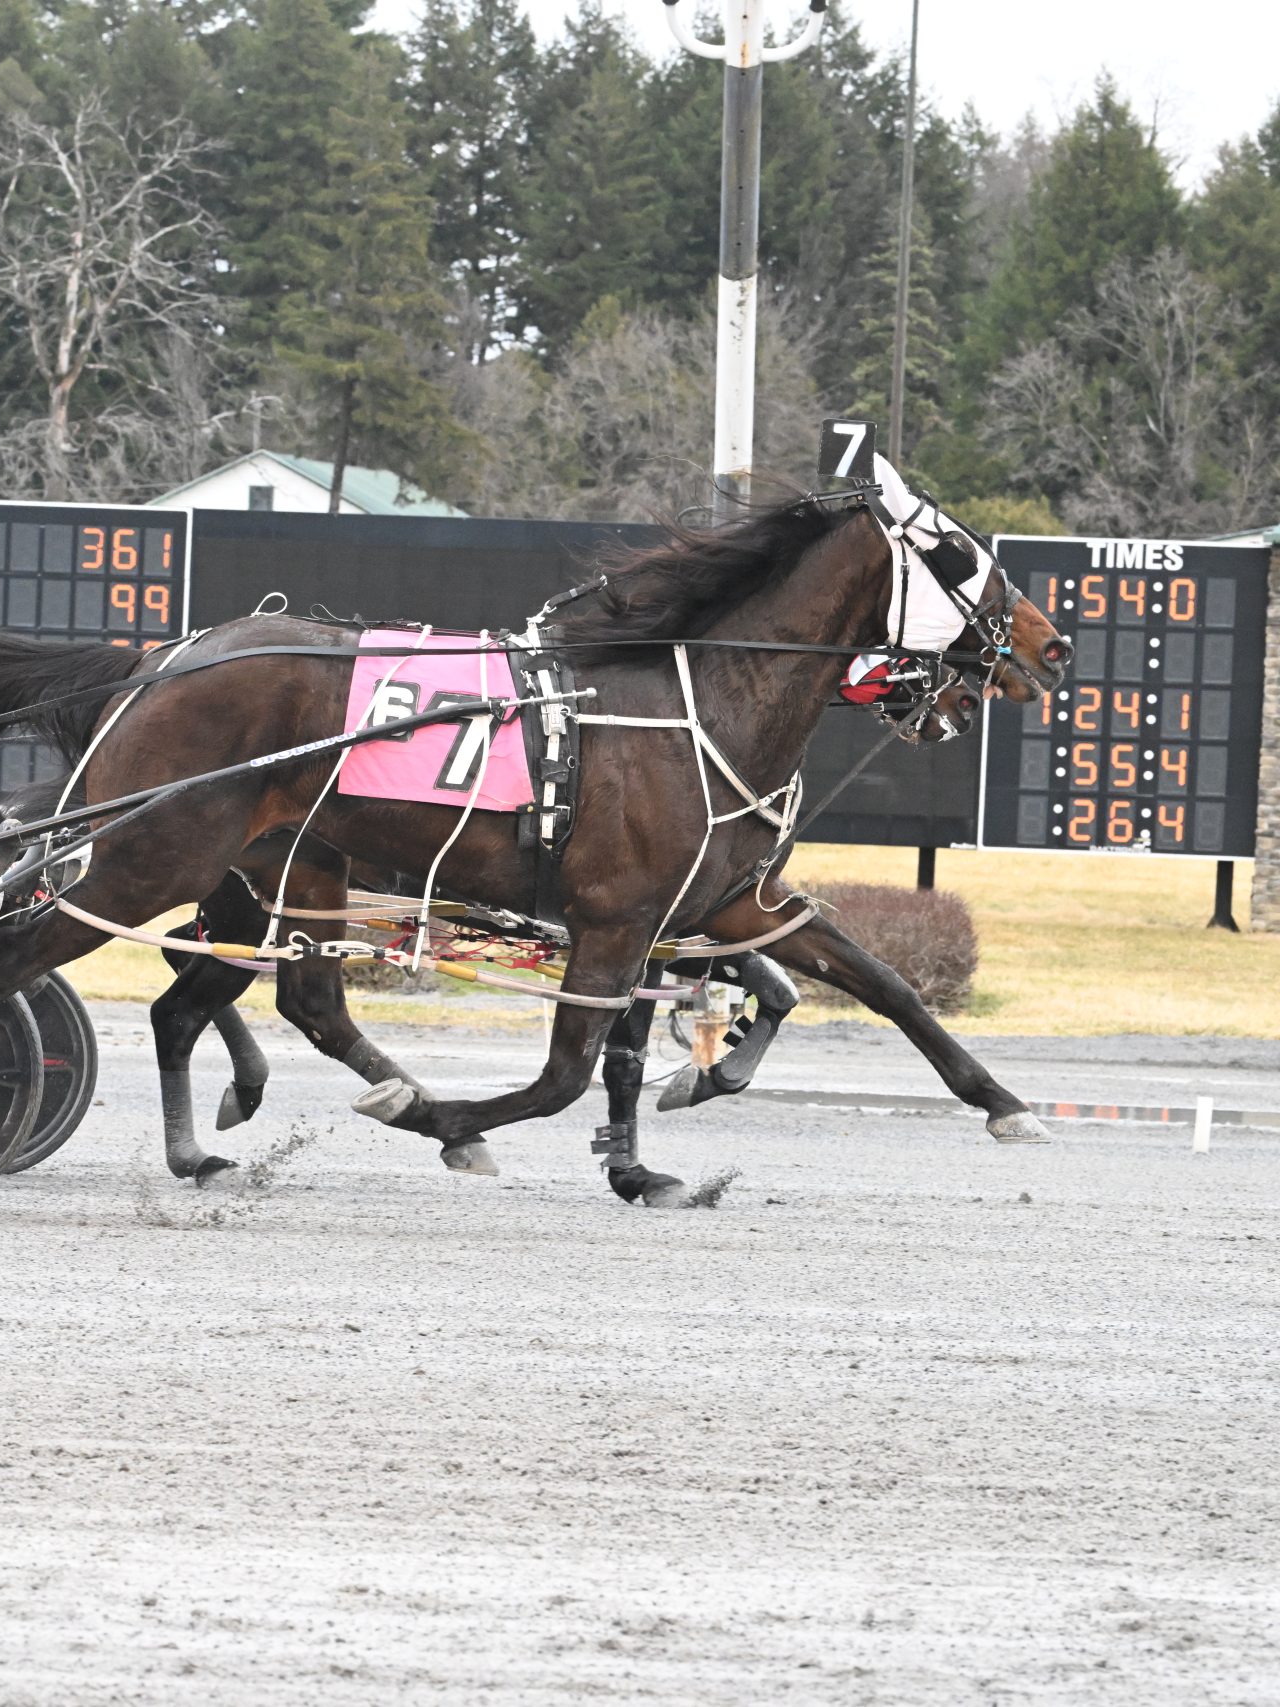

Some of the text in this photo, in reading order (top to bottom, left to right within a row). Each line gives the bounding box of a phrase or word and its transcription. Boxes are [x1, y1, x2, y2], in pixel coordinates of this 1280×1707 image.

[832, 423, 867, 478] 7
[81, 527, 172, 571] 361
[1086, 542, 1184, 571] TIMES
[111, 583, 170, 624] 99
[436, 700, 495, 785] 7
